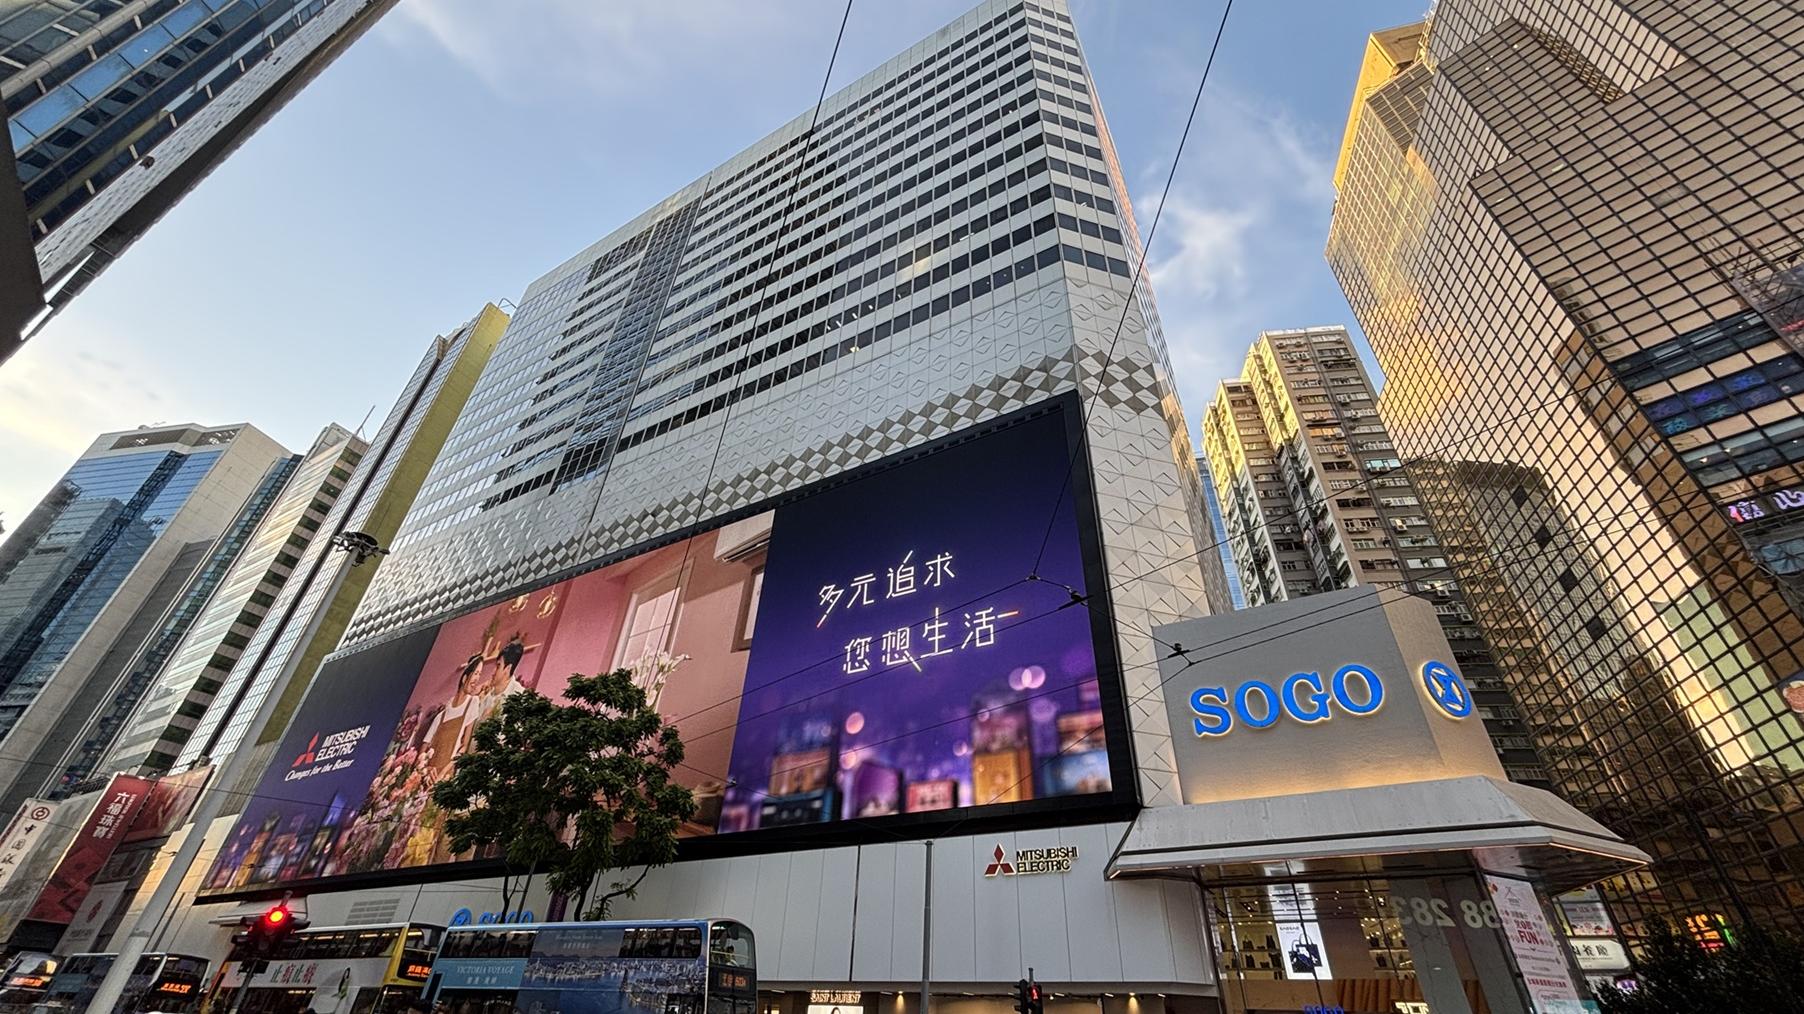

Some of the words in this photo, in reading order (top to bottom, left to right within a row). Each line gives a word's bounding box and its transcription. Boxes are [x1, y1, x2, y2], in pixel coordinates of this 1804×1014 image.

[817, 550, 955, 628] 多元追求
[842, 607, 1019, 674] 您想生活
[1190, 664, 1384, 736] SOGO
[322, 725, 371, 748] MITSUBISHI
[315, 741, 357, 762] ELECTRIC
[1016, 846, 1078, 861] MITSUBISHI
[1017, 859, 1070, 873] ELECTRIC
[1518, 930, 1541, 945] FUN
[456, 965, 487, 975] VICTORIA
[488, 965, 515, 975] VOYAGE
[810, 992, 830, 1003] SAINT
[829, 992, 862, 1004] LAURENT
